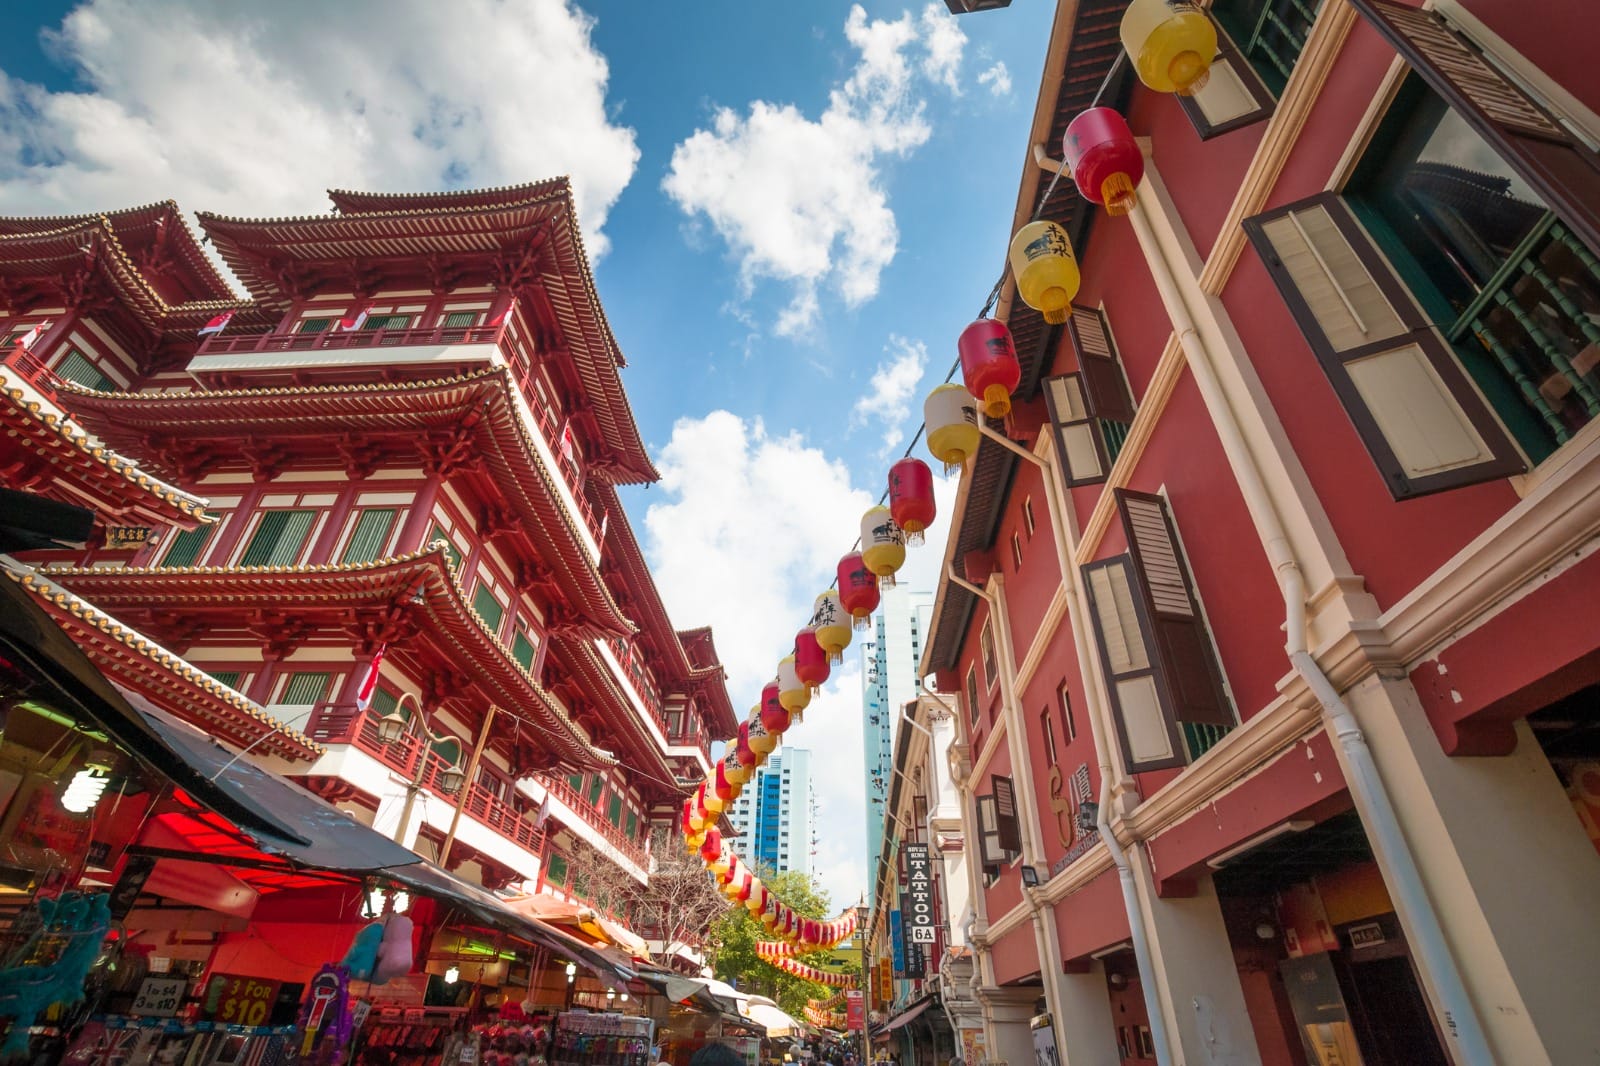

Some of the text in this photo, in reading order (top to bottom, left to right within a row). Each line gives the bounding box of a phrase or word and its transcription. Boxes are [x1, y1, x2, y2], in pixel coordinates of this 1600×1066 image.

[910, 860, 930, 925] TATTOO
[915, 928, 934, 940] 6A
[162, 984, 177, 996] $4
[231, 979, 272, 999] 3 FOR
[136, 997, 146, 1008] 3
[156, 997, 176, 1011] $10
[222, 997, 267, 1027] $10
